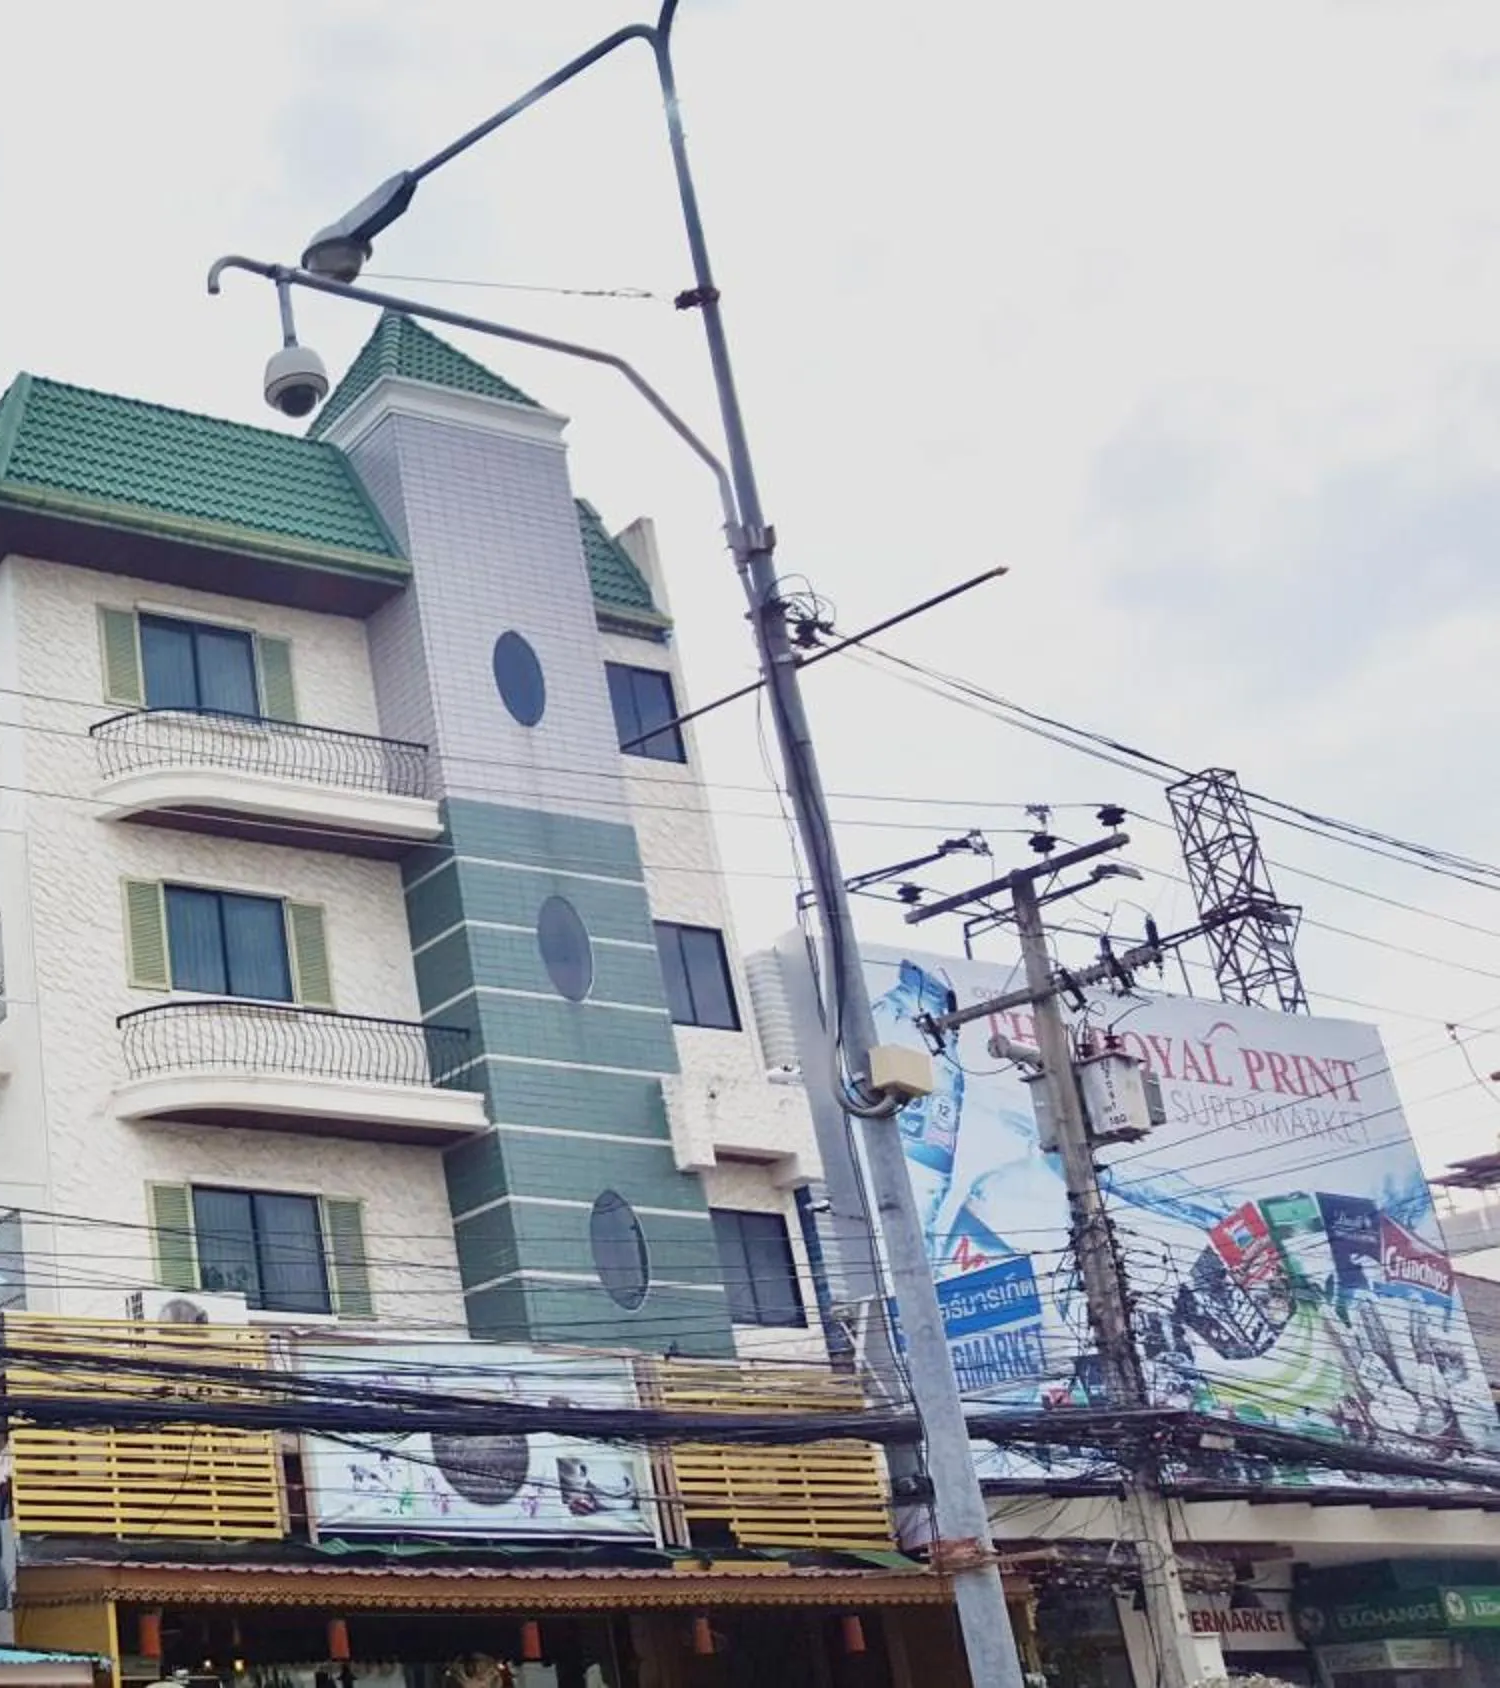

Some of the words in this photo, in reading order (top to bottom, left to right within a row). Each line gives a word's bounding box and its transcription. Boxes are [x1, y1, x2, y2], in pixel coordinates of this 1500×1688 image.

[1239, 1047, 1361, 1103] PRINT
[1169, 1088, 1372, 1145] SUPERMARKET
[1385, 1245, 1449, 1292] Crunchips
[1337, 1602, 1441, 1629] EXCHANGE
